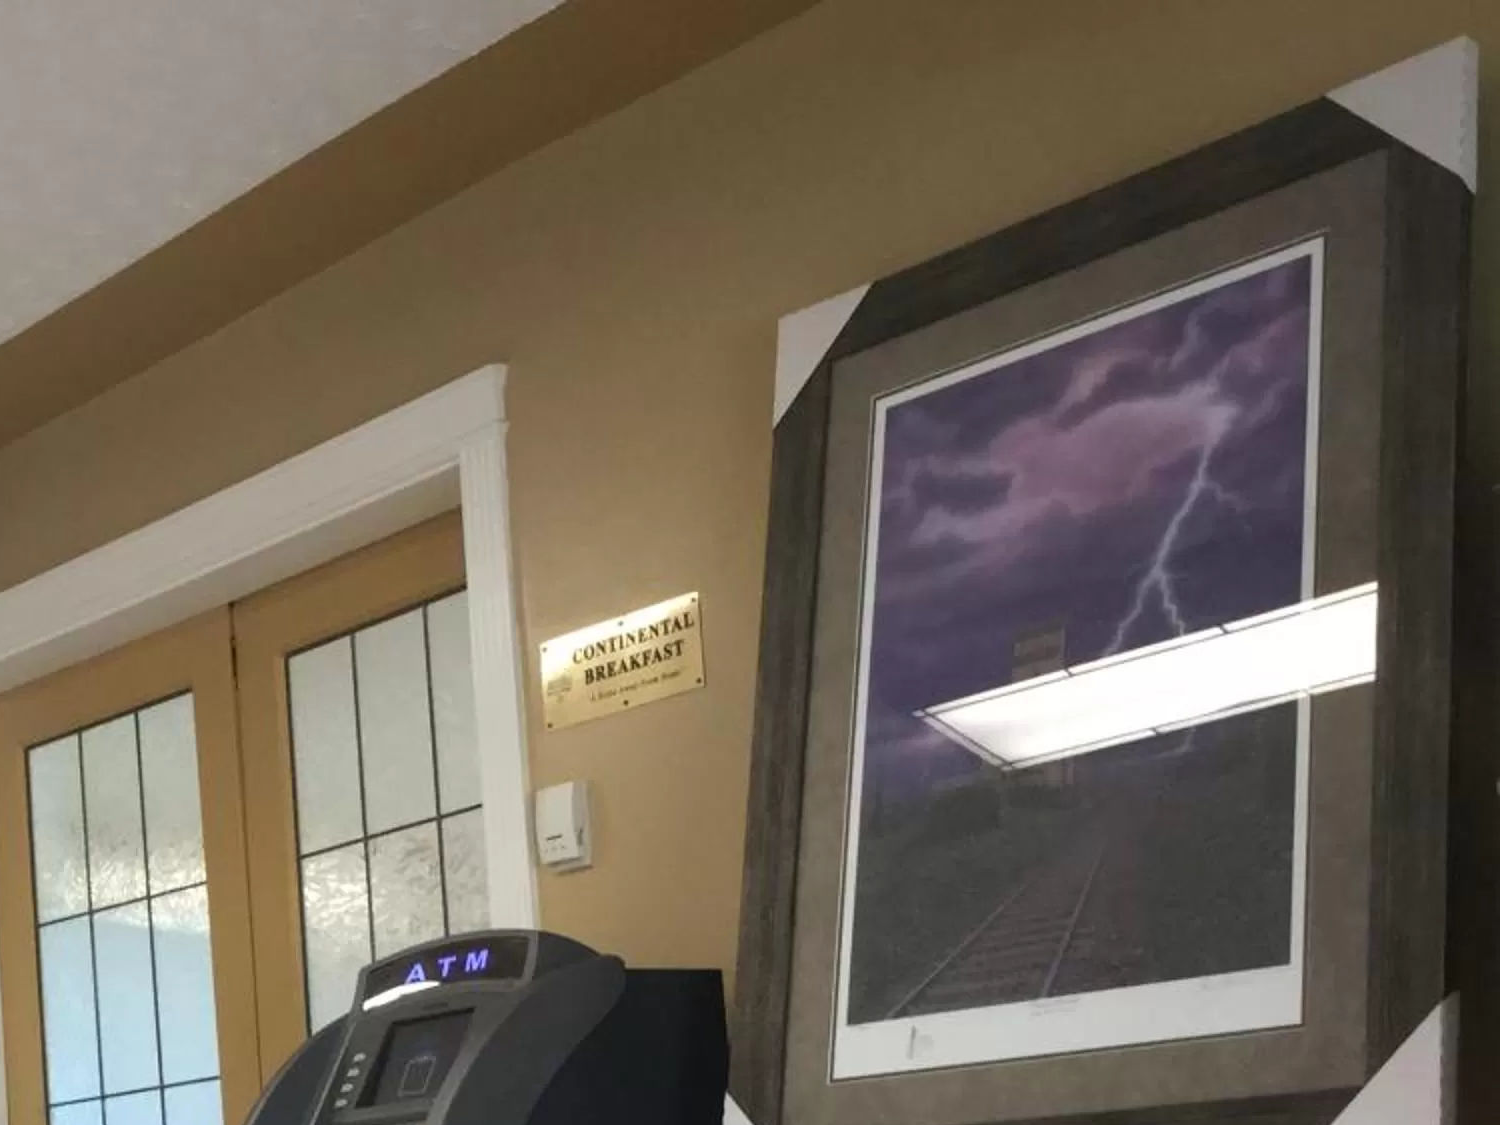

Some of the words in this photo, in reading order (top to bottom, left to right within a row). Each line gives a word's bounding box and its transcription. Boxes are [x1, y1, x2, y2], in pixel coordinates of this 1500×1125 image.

[572, 611, 695, 664] CONTINENTAL
[584, 639, 685, 685] BREAKFAST
[404, 948, 490, 984] ATM
